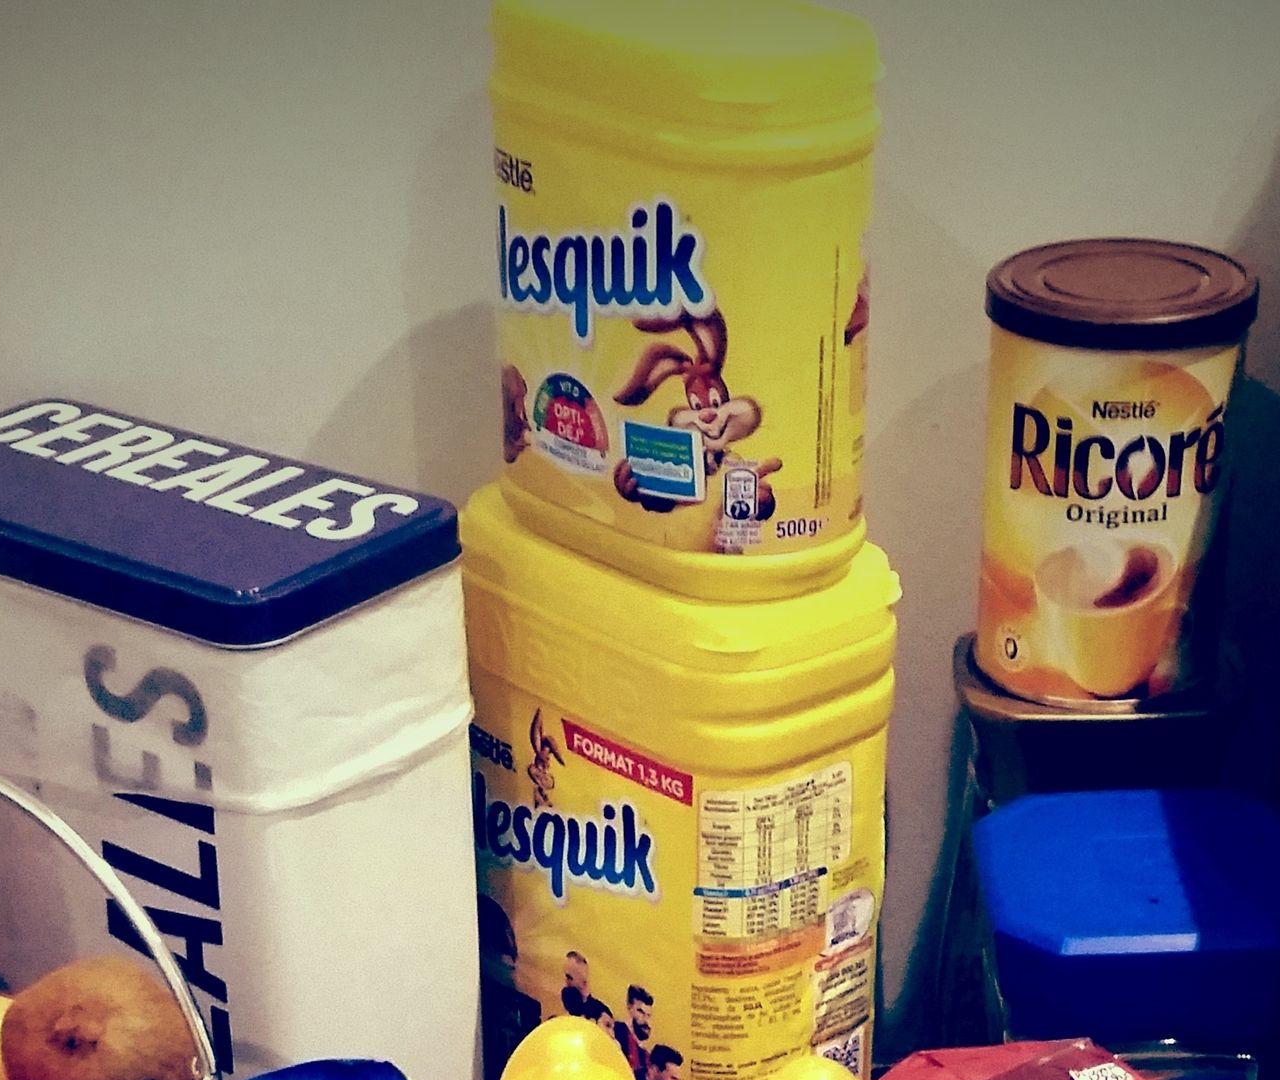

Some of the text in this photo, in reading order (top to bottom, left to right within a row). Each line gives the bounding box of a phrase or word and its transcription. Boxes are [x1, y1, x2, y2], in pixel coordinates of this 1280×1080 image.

[1092, 400, 1157, 420] Nestlé
[1009, 401, 1225, 501] Ricoré
[1066, 503, 1168, 529] Original
[572, 733, 684, 798] FORMAT 1,3 KG
